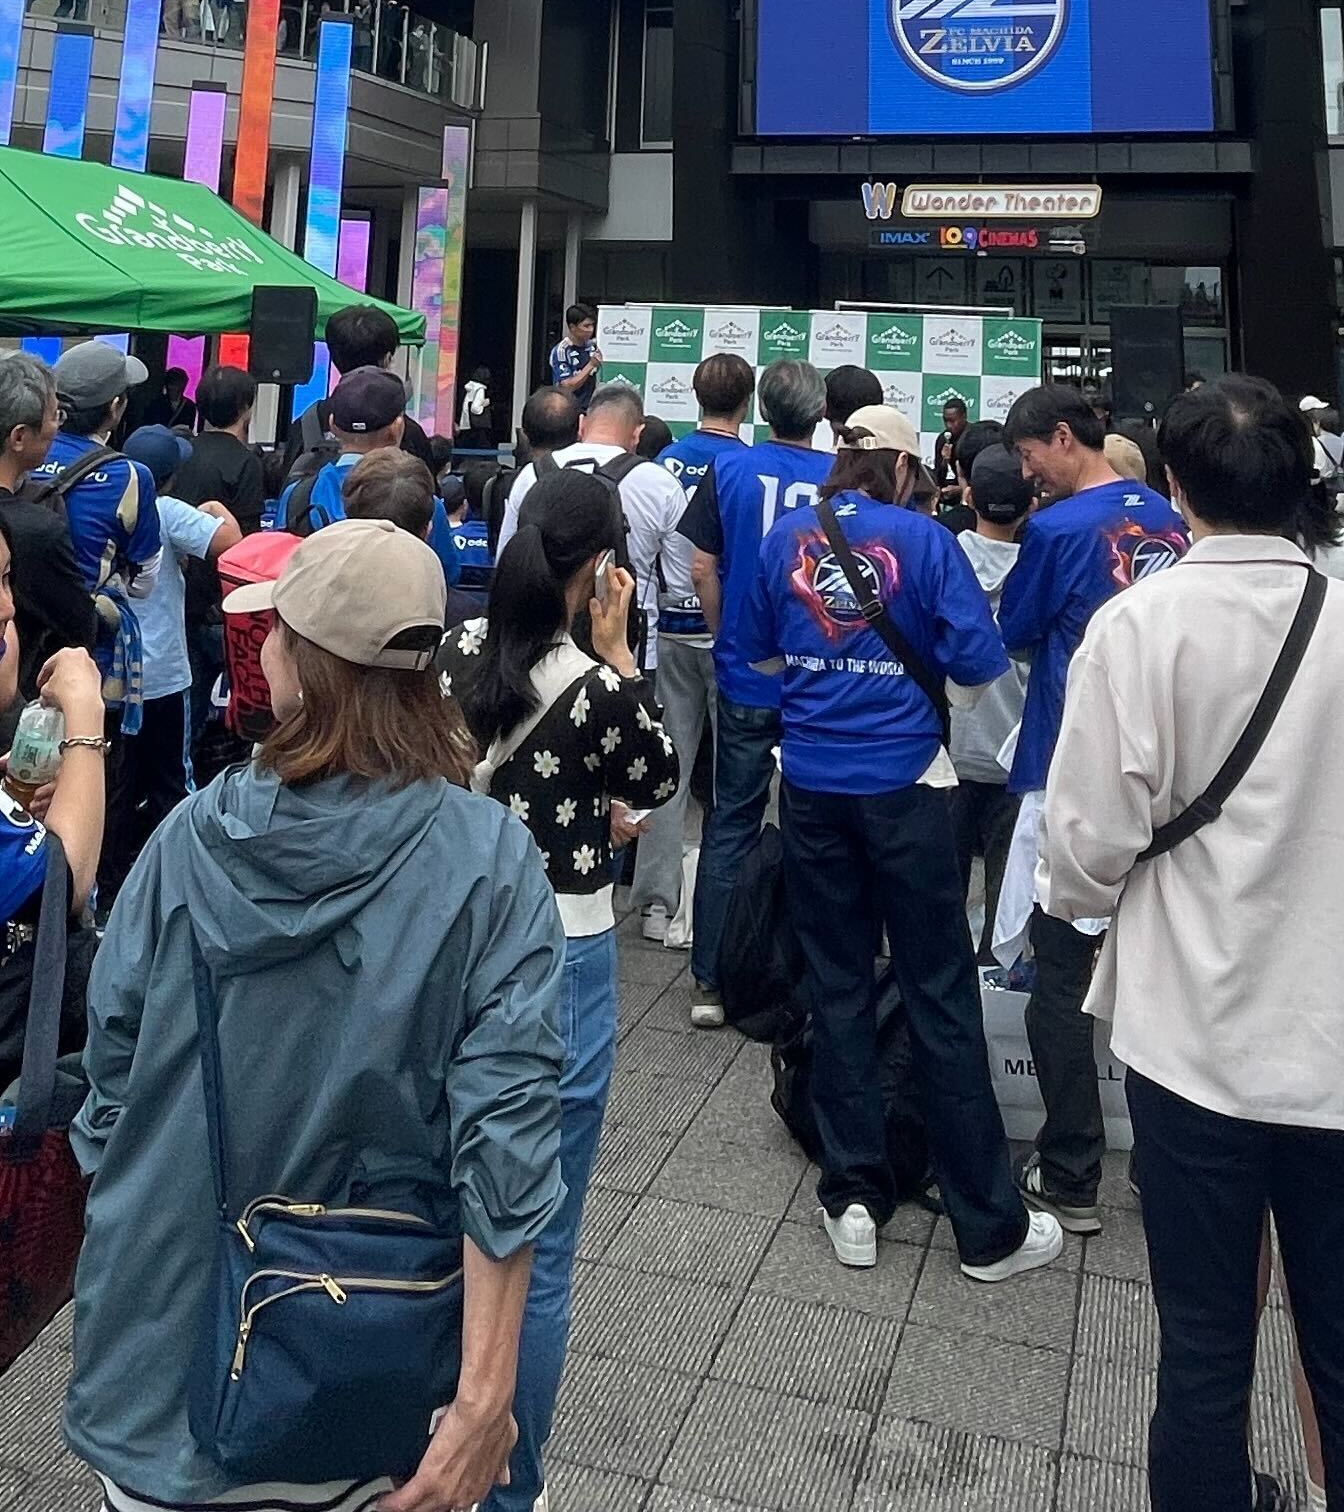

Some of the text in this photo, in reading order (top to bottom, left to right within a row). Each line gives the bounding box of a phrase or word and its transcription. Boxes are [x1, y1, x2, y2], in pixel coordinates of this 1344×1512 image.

[919, 29, 1036, 54] ZELVIA
[911, 192, 998, 211] Wonder
[1004, 192, 1093, 212] Theater
[75, 212, 264, 264] Grandberry
[880, 232, 930, 244] IMAX
[830, 658, 844, 671] TO
[847, 658, 866, 673] THE
